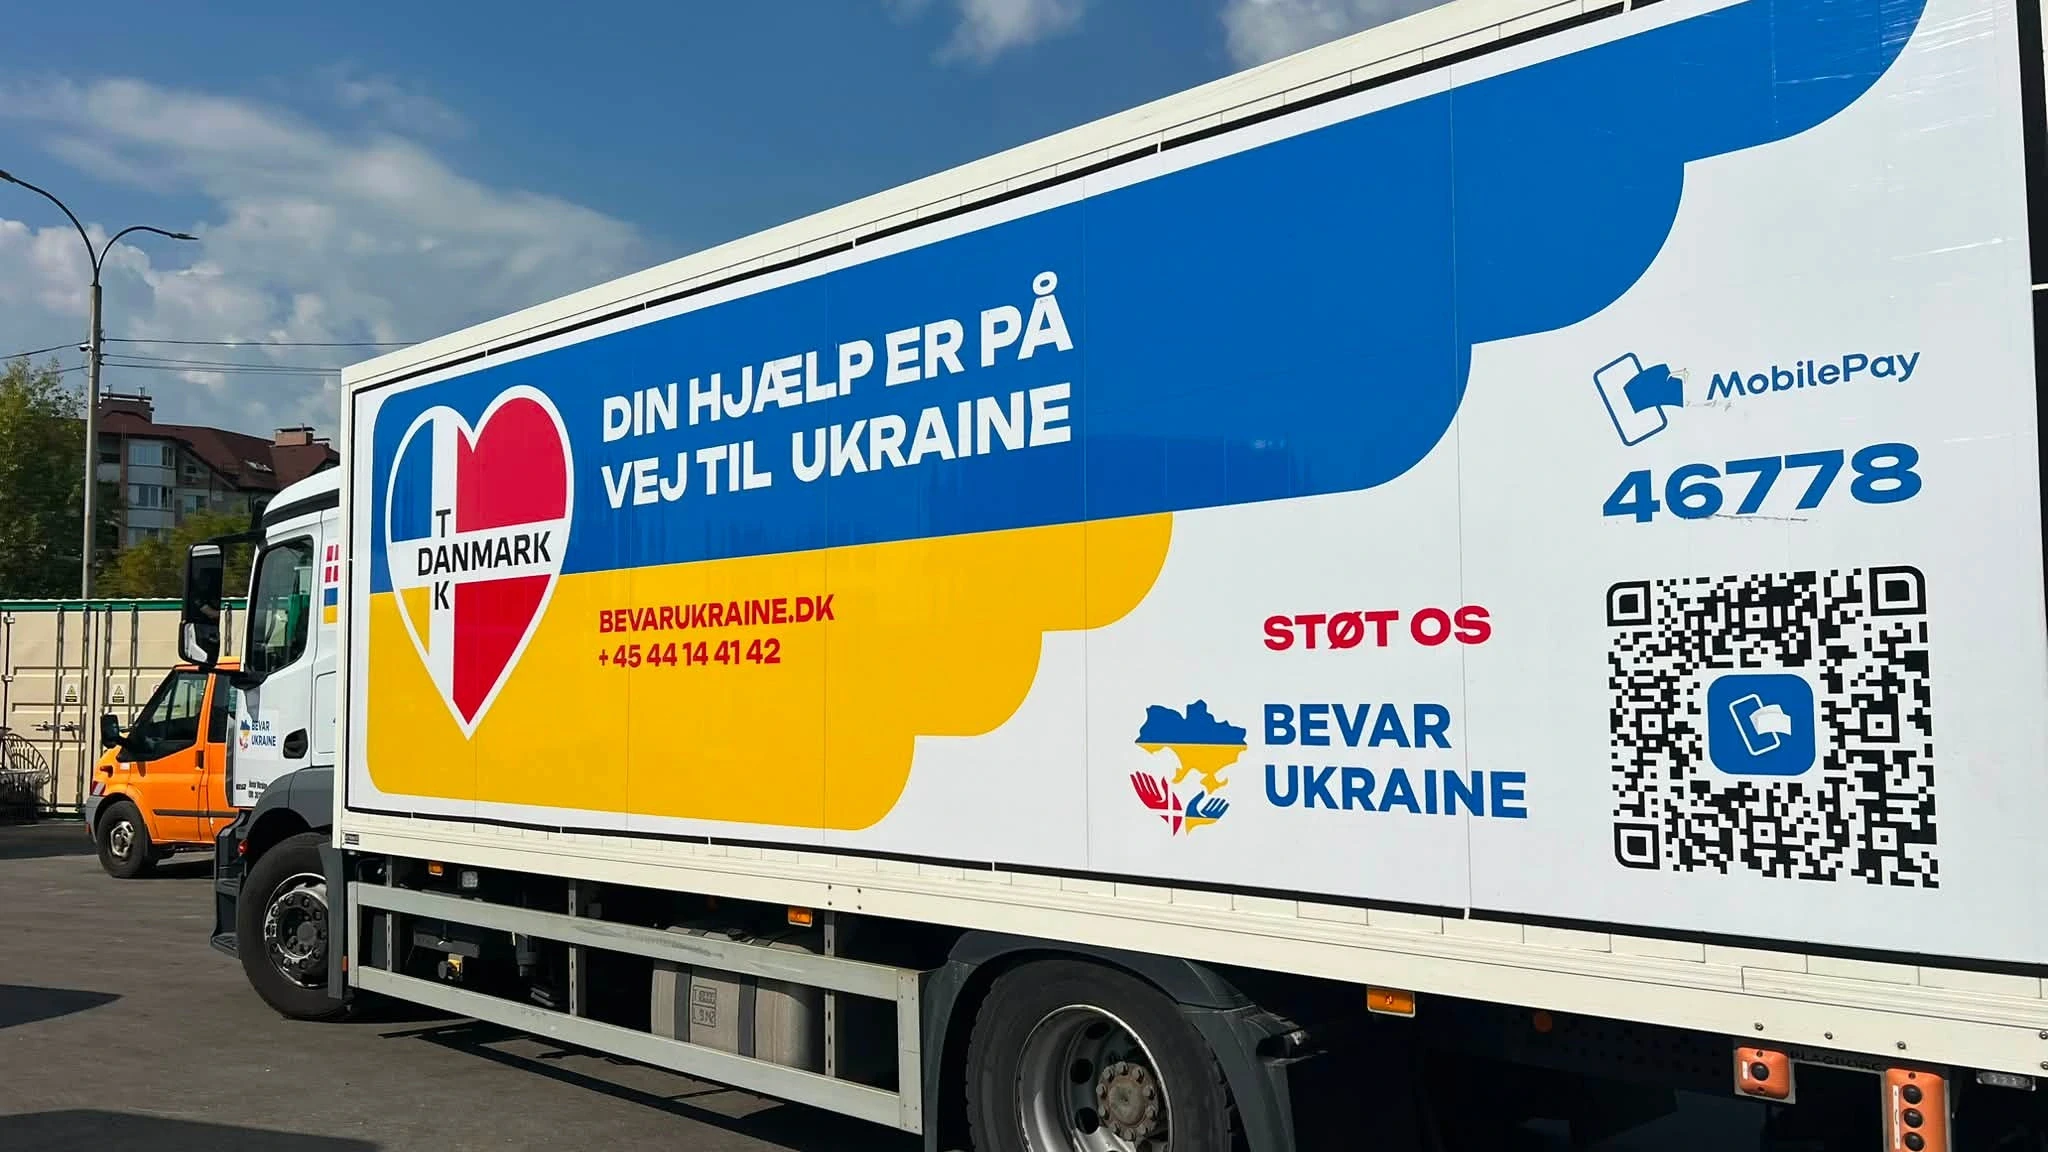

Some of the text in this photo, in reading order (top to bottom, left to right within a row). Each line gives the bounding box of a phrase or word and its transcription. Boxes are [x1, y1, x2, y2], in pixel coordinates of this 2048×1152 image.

[602, 270, 1074, 443] DIN HJÆLP ER PÅ
[1706, 351, 1920, 401] MobilePay
[601, 382, 1072, 509] VEJ TIL UKRAINE
[1602, 442, 1922, 524] 46778
[417, 530, 551, 576] DANMARK
[599, 594, 835, 634] BEVARUKRAINE.DK
[1263, 605, 1492, 651] STØT OS
[646, 642, 677, 667] 44
[682, 642, 709, 666] 14
[713, 640, 741, 665] 41
[746, 637, 782, 665] 42
[251, 720, 270, 731] BEVAR
[251, 735, 276, 746] UKRAINE
[1263, 703, 1452, 749] BEVAR
[1264, 764, 1528, 819] UKRAINE
